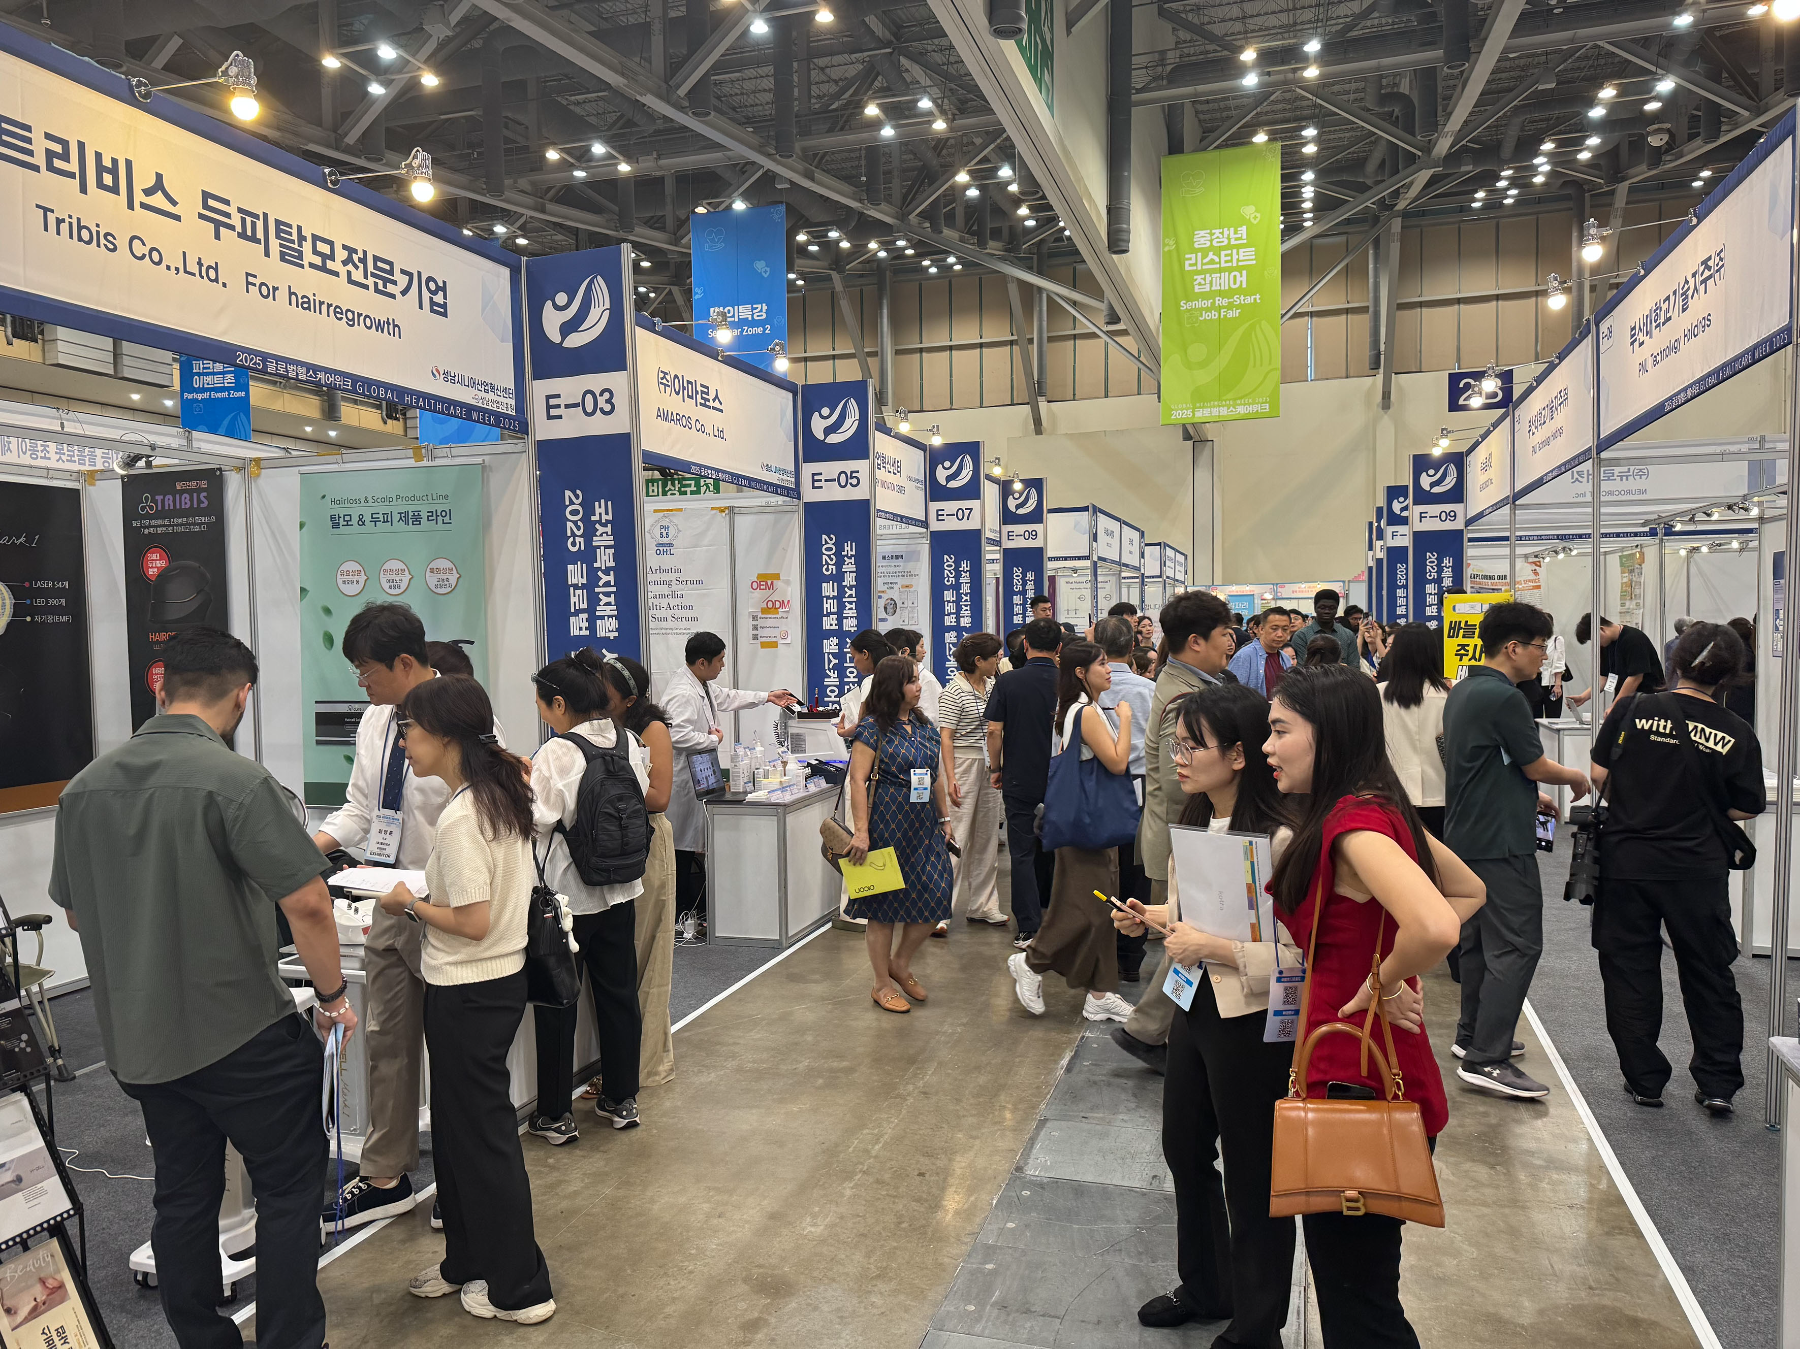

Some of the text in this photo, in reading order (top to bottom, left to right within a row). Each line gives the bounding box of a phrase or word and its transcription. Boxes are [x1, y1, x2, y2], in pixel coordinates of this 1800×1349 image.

[0, 114, 449, 319] 트리비스 두피탈모전문기업
[1193, 225, 1247, 248] 중장년
[1184, 247, 1257, 271] 리스타트
[35, 203, 402, 340] Tribis Co.,Ltd. For hairregrowth
[1193, 270, 1247, 293] 잡페어
[1180, 293, 1261, 311] Senior Re-Start
[1199, 307, 1241, 321] Job Fair
[742, 325, 763, 336] Zone
[765, 324, 771, 334] 2
[193, 374, 236, 388] 이벤트존
[236, 351, 520, 431] 2025 글로벌헬스케어위크 GLOBAL HEALTHCARE WEEK 2025
[657, 366, 724, 414] (주)아마로스
[184, 390, 246, 400] Parkgolf Event Zone
[545, 387, 616, 421] E-03
[1171, 404, 1270, 419] 2025 글로벌헬스케어위크
[656, 406, 727, 442] AMAROS Co., Ltd.
[648, 479, 697, 497] 비상구
[811, 470, 861, 490] E-05
[155, 492, 209, 511] TRIBIS
[330, 492, 450, 506] Hairloss & Scalp Product Line
[329, 508, 453, 529] 탈모 & 두피 제품 라인
[564, 489, 585, 552] 2025
[935, 507, 974, 522] E-07
[1419, 510, 1457, 523] F-09
[1007, 529, 1038, 541] E-09
[821, 534, 837, 576] 2025
[591, 499, 619, 640] 국제복지재활
[647, 565, 682, 575] Arbutin
[1469, 572, 1496, 581] EXPLORING
[675, 576, 704, 586] Serum
[750, 580, 775, 591] OEM
[842, 541, 859, 633] 국제복지재활
[943, 554, 957, 626] 2025 글로벌
[1396, 563, 1407, 615] 2025 글로벌
[1425, 552, 1438, 616] 2025 글로벌
[33, 598, 46, 606] LED
[567, 561, 590, 637] 글로벌
[959, 559, 972, 628] 국제복지재활
[1012, 567, 1023, 624] 2025 글로벌
[766, 600, 791, 610] ODM
[822, 580, 840, 631] 글로벌
[34, 615, 72, 623] 자기장(EMF)
[650, 613, 699, 623] Sun Serum
[3, 1251, 54, 1290] Beauty
